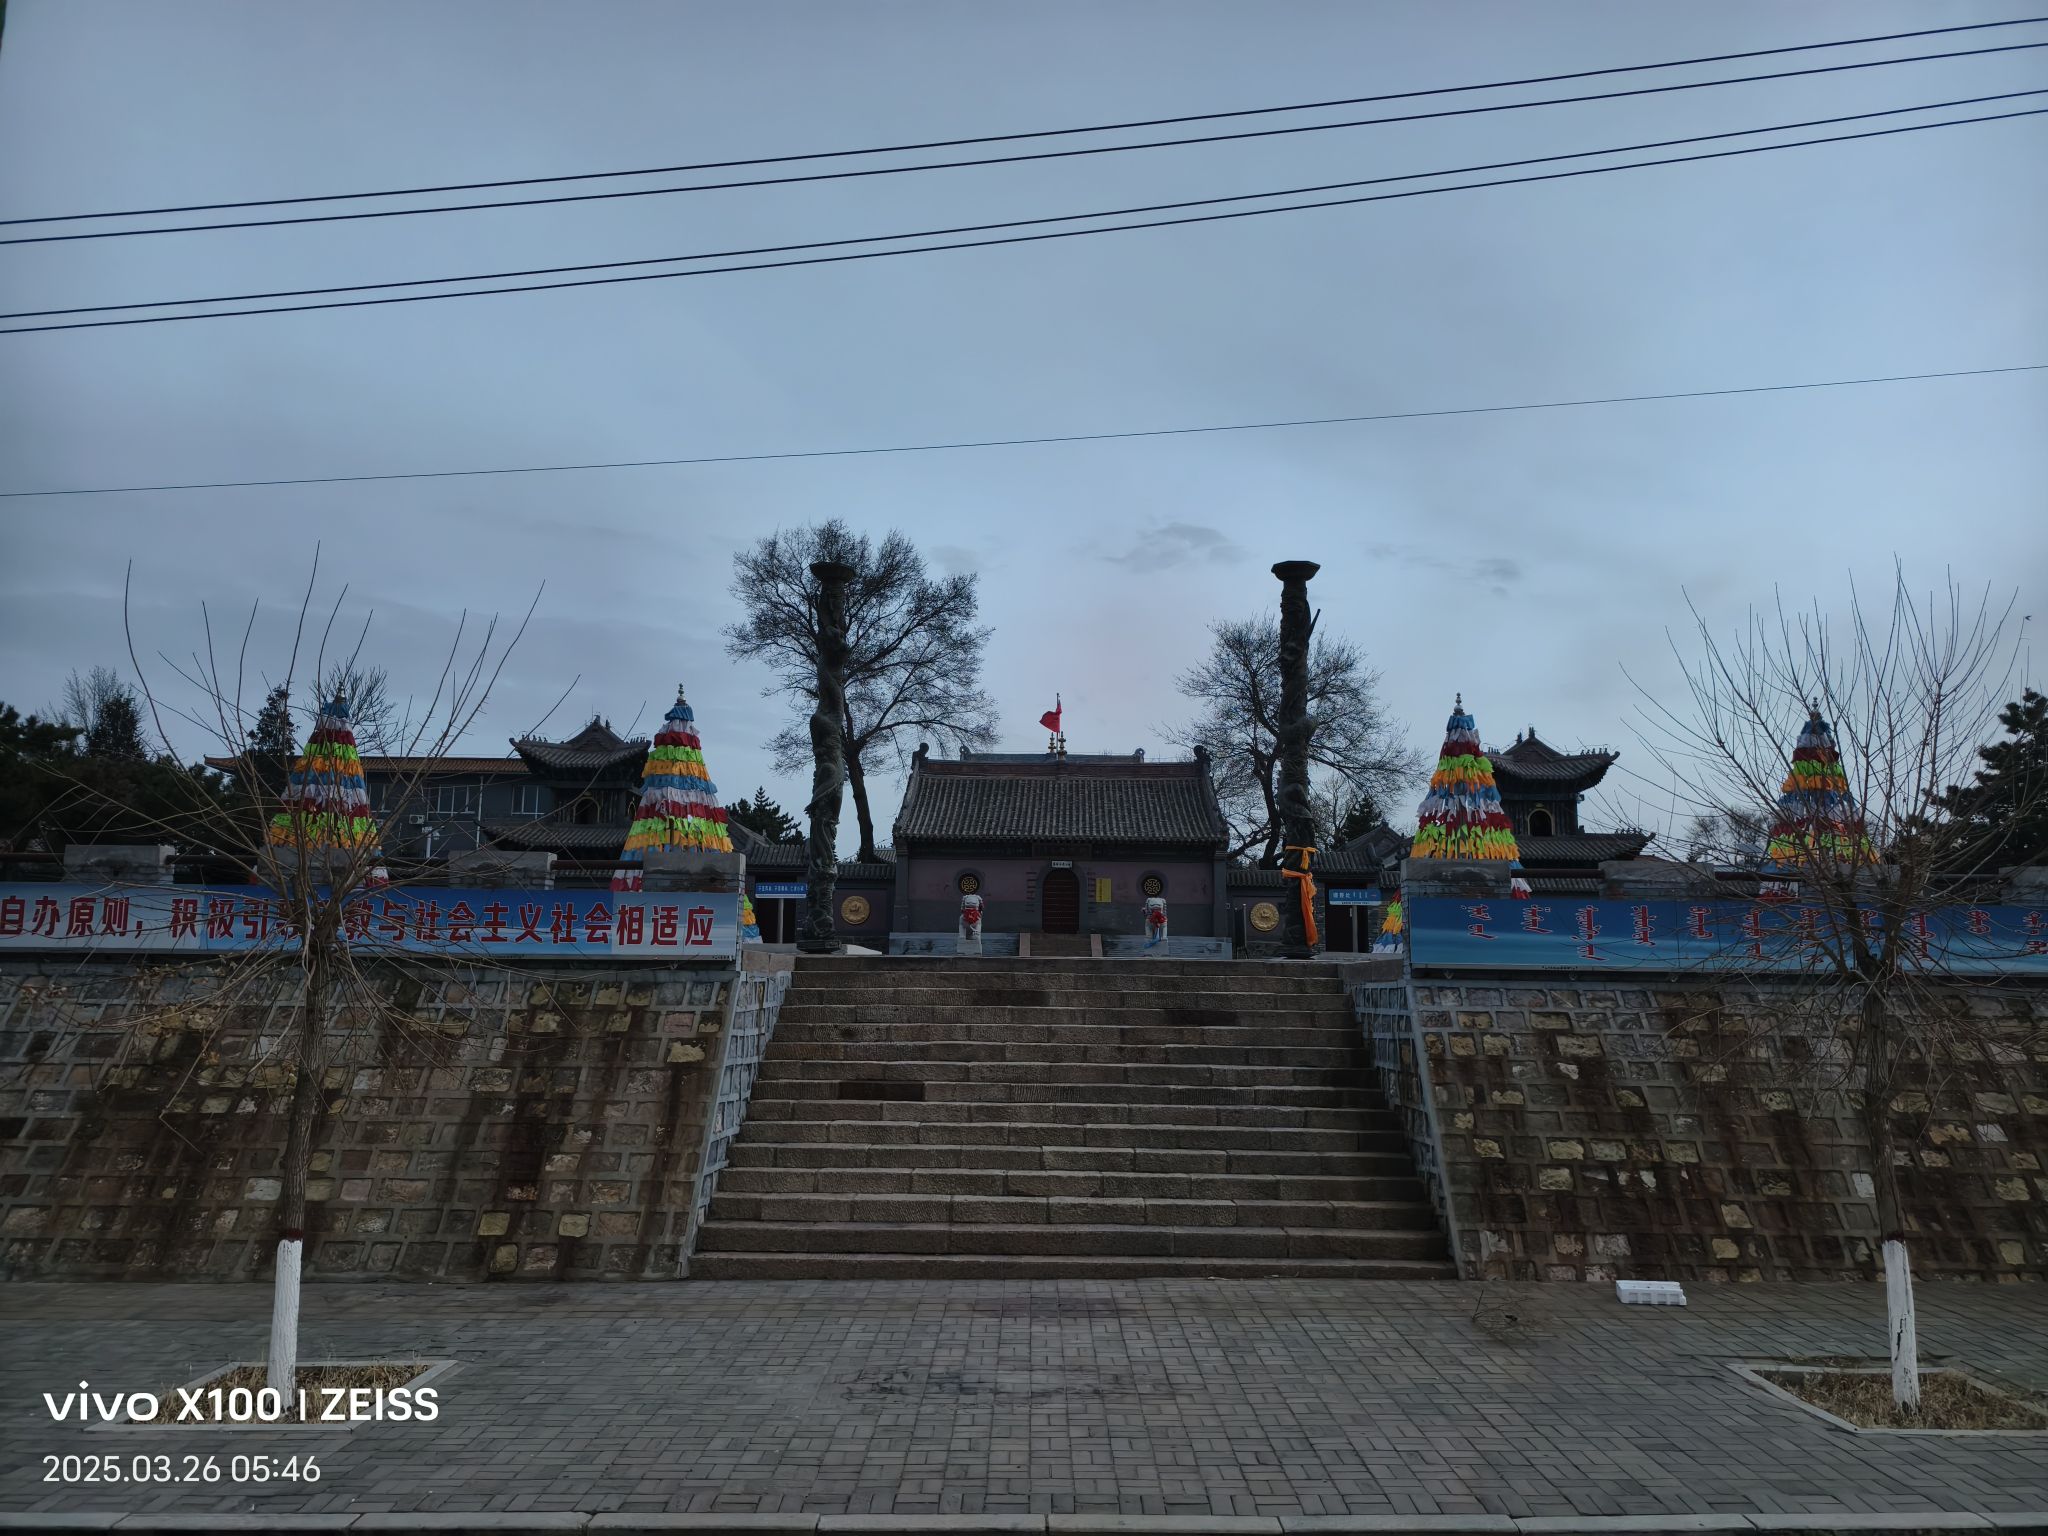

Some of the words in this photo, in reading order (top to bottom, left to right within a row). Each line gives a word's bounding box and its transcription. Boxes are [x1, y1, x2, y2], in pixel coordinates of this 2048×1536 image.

[0, 895, 715, 947] 自办原则，积极引导教与社会主义社会相适应
